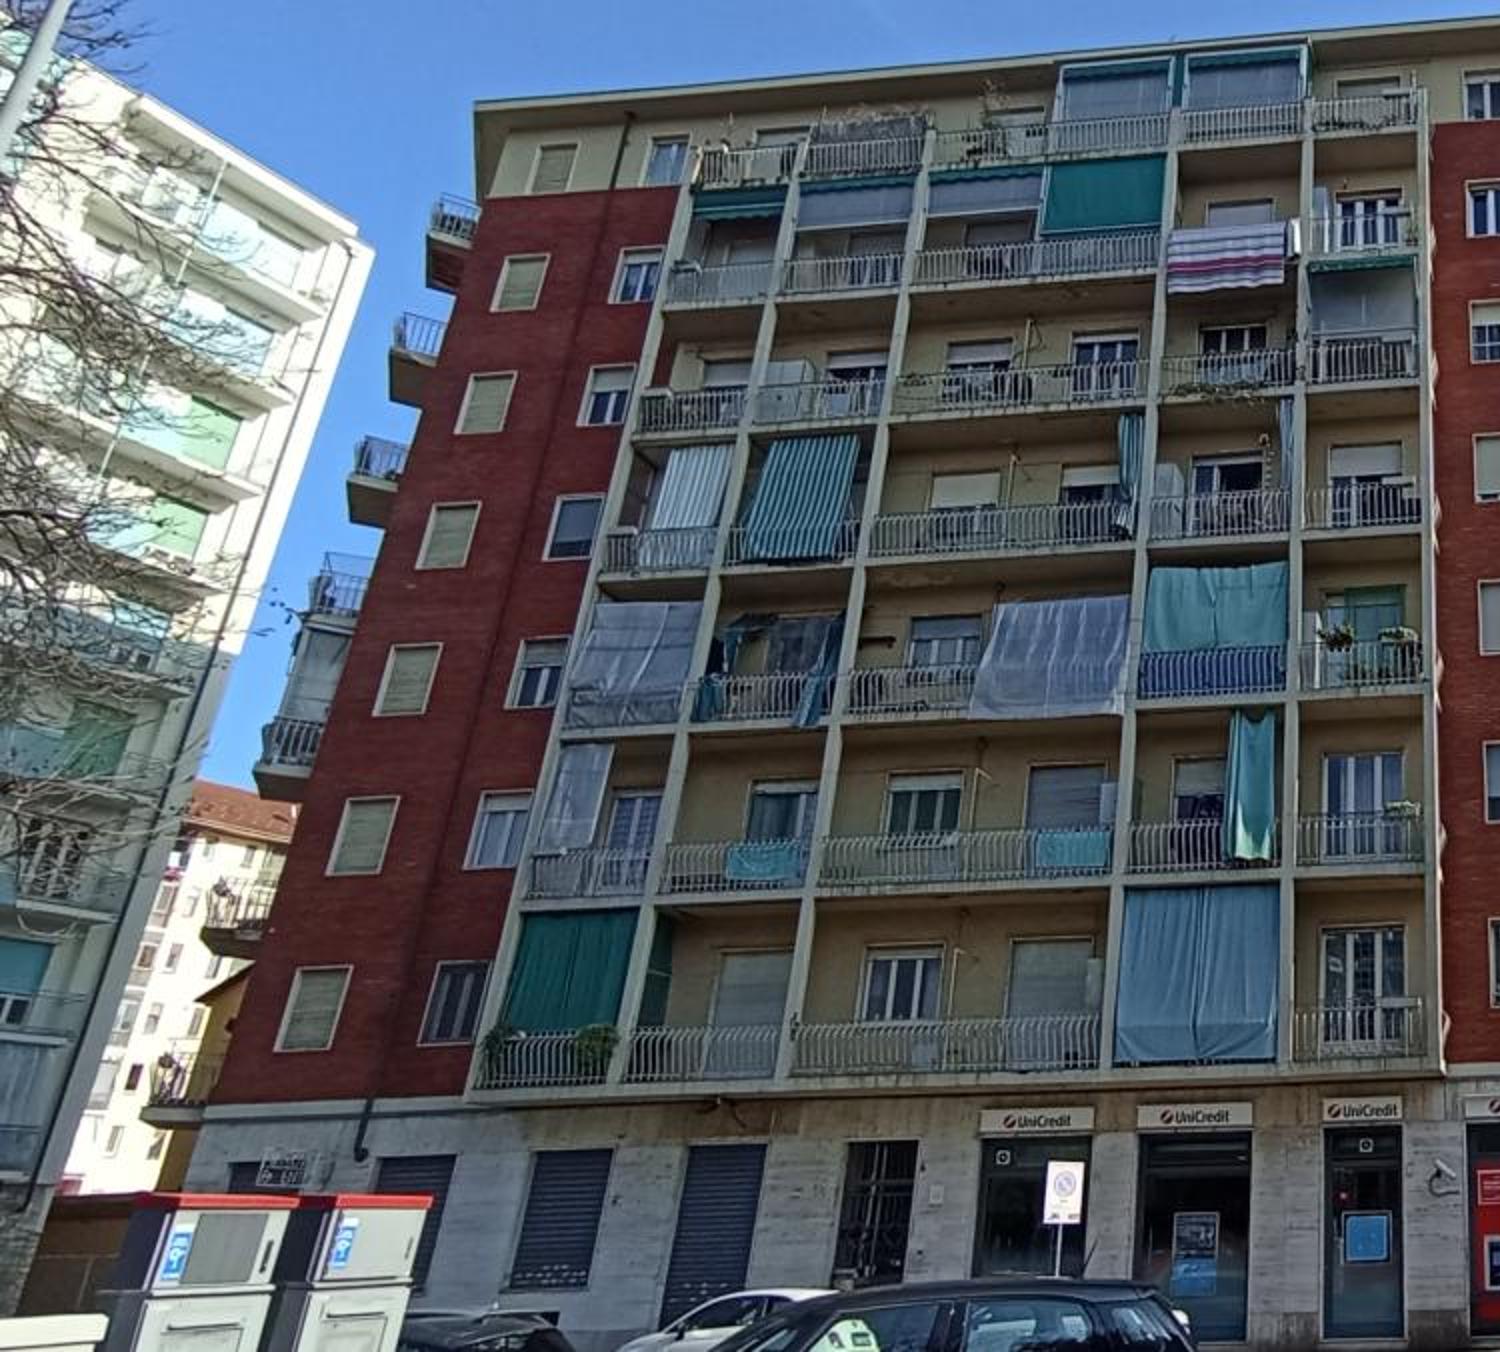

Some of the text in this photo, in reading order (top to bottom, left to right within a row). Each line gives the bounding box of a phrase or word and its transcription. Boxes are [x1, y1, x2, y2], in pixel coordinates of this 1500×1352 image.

[1174, 1109, 1229, 1126] UniCredit
[1343, 1102, 1398, 1120] UniCredit
[1017, 1112, 1072, 1130] UniCredit
